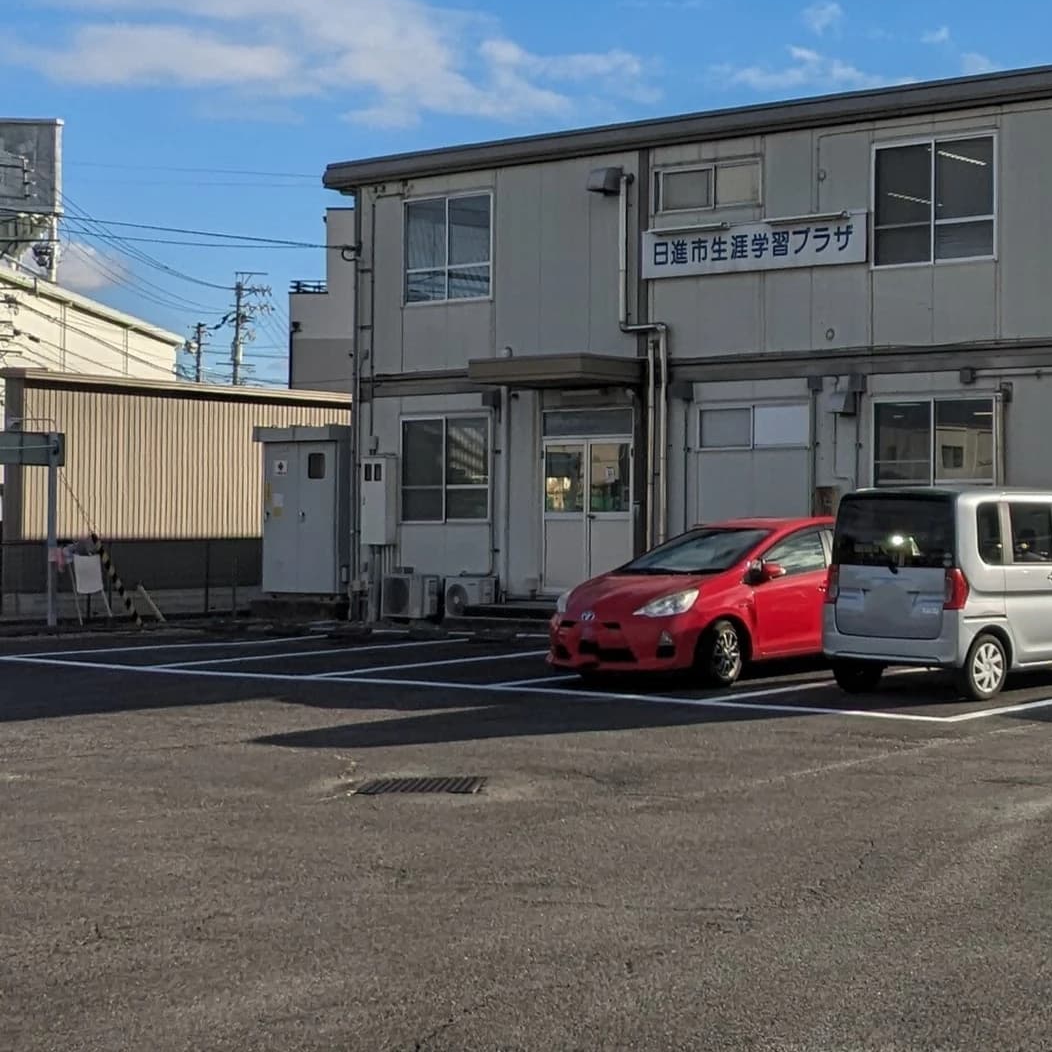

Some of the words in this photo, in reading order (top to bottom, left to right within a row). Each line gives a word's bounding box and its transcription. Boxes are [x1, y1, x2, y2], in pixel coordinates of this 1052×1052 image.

[653, 224, 853, 266] 日進市生涯学習プラザ
